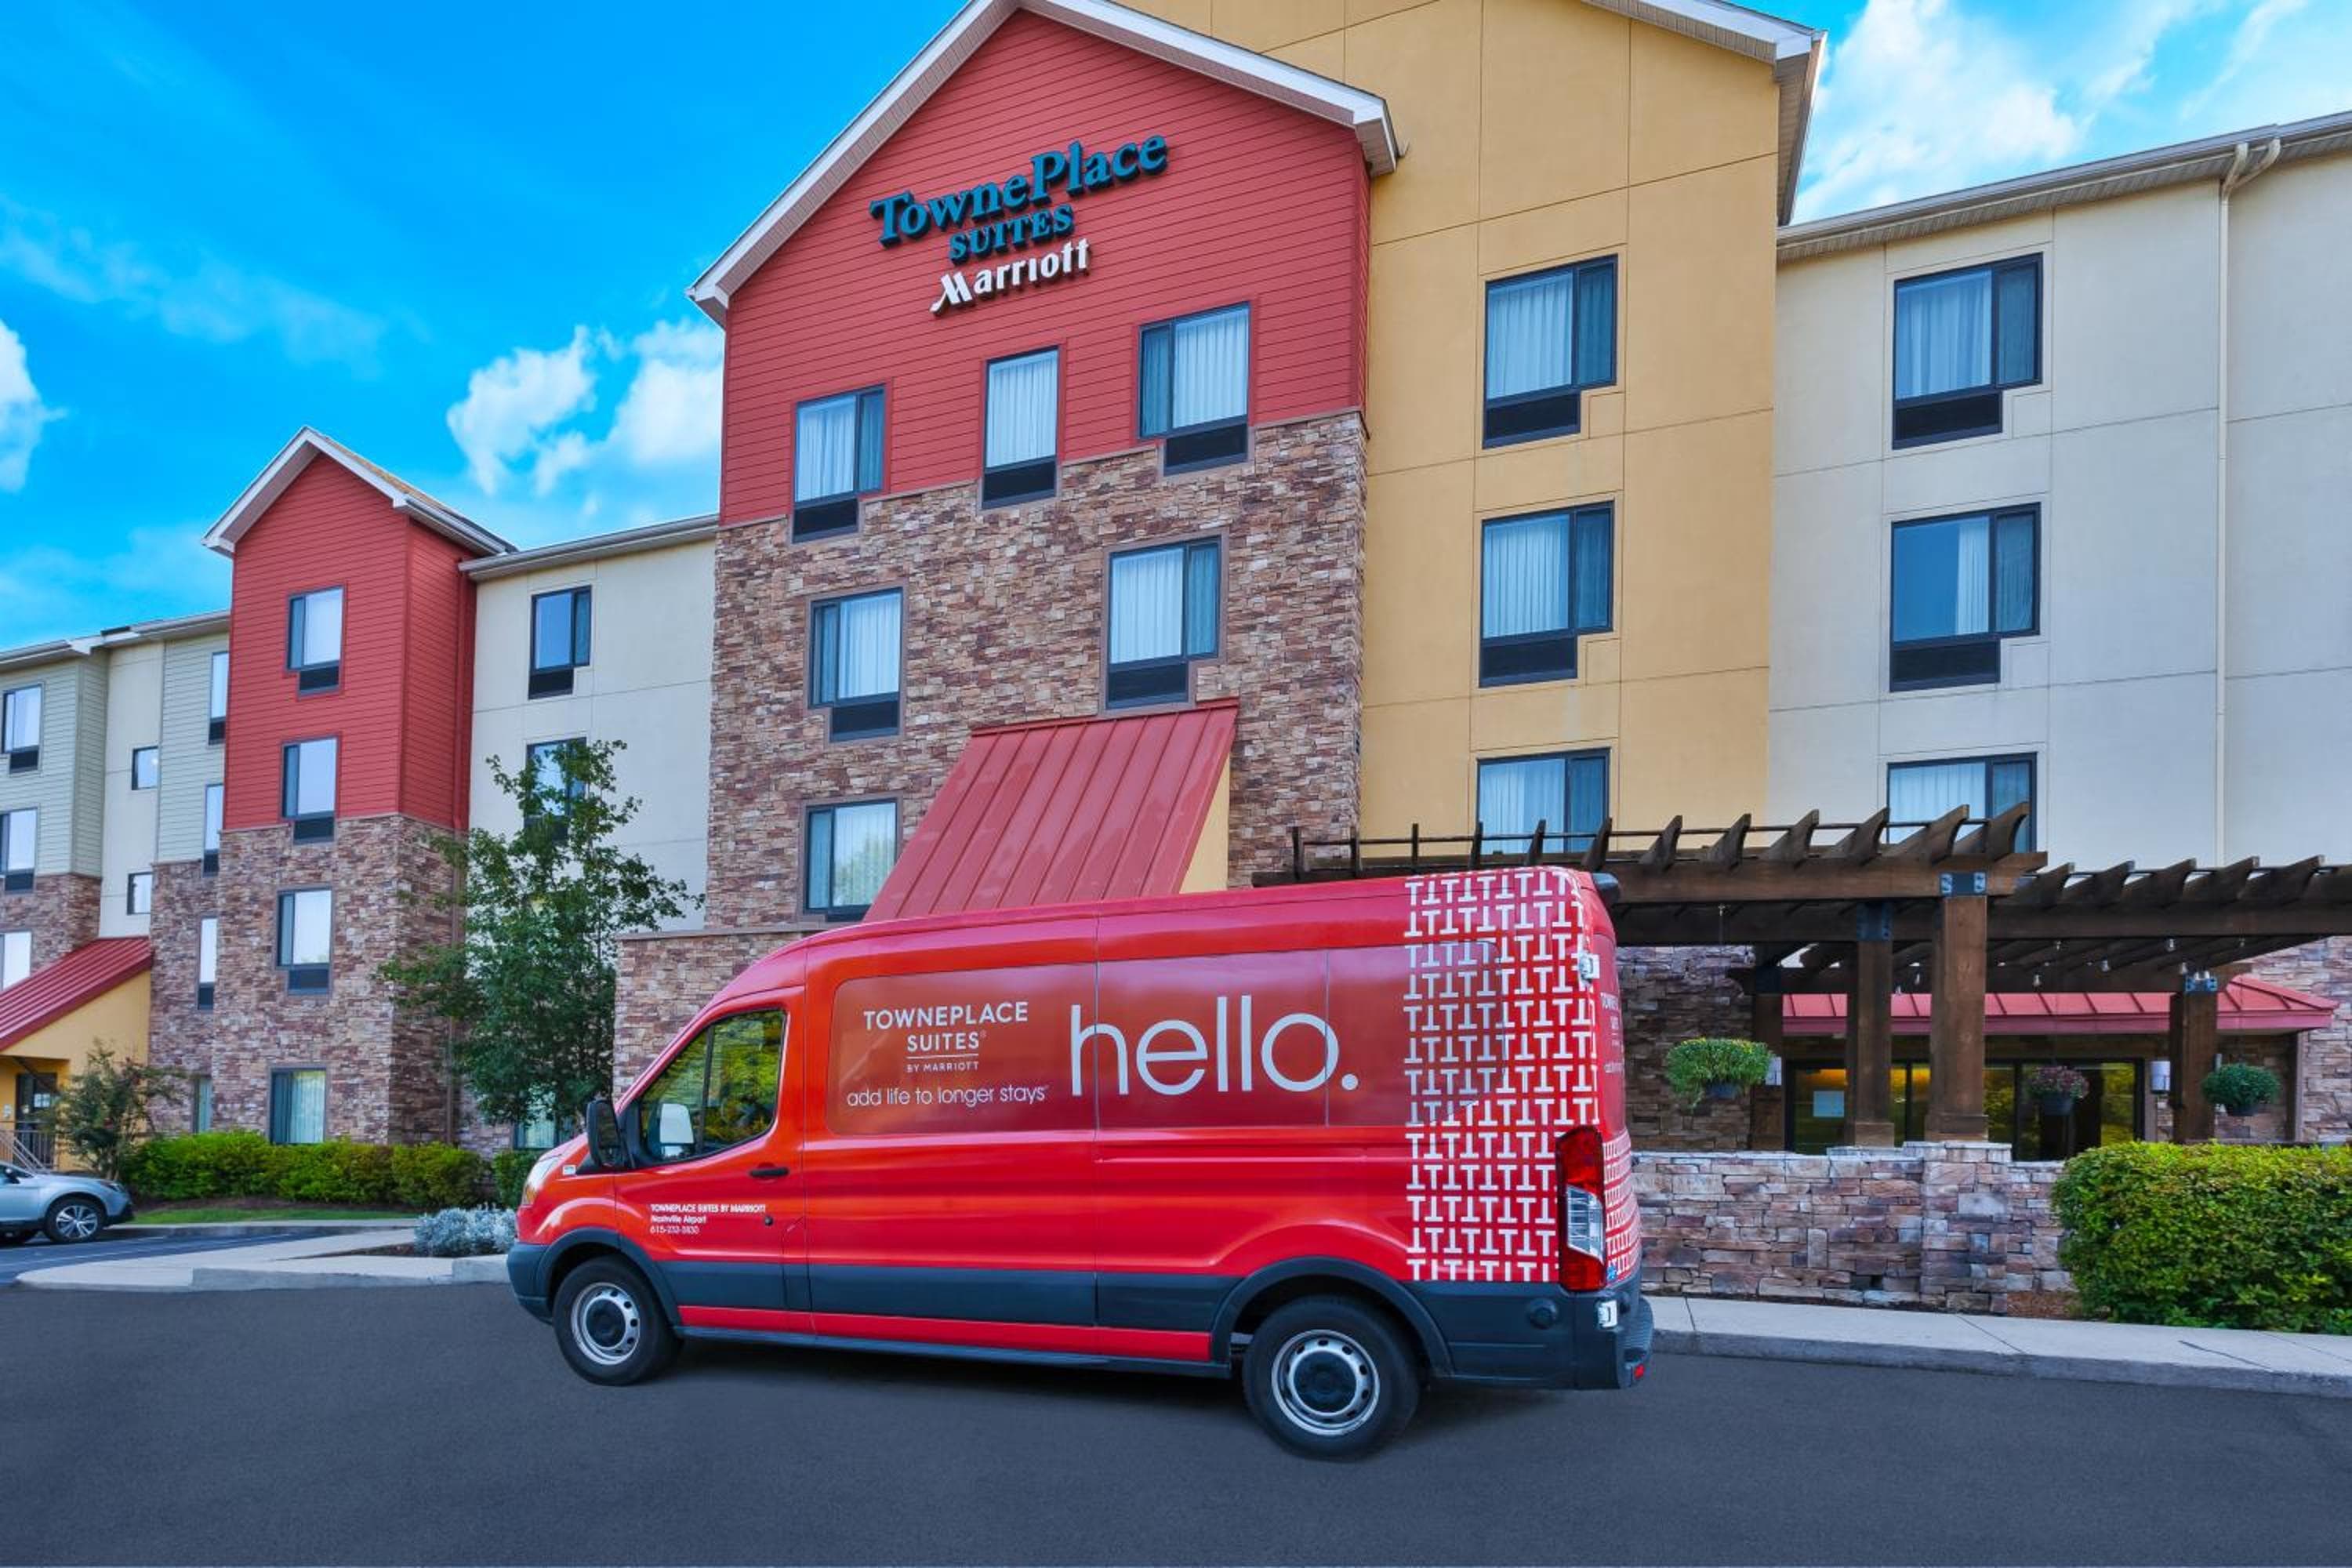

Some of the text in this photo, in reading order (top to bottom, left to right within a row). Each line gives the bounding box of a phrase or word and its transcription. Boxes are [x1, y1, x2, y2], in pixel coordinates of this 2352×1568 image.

[869, 134, 1169, 248] TownePlace
[949, 203, 1075, 265] SUITES
[929, 238, 1091, 316] Marriott
[863, 1001, 1029, 1030] TOWNEPLACE
[1071, 995, 1359, 1096] hello.
[906, 1061, 979, 1073] BY MARRIOTT
[847, 1083, 1045, 1108] add life to longer stays
[650, 1203, 696, 1213] TOWNEPLACE
[698, 1203, 719, 1213] SUITES
[650, 1215, 706, 1225] Nashville Airport
